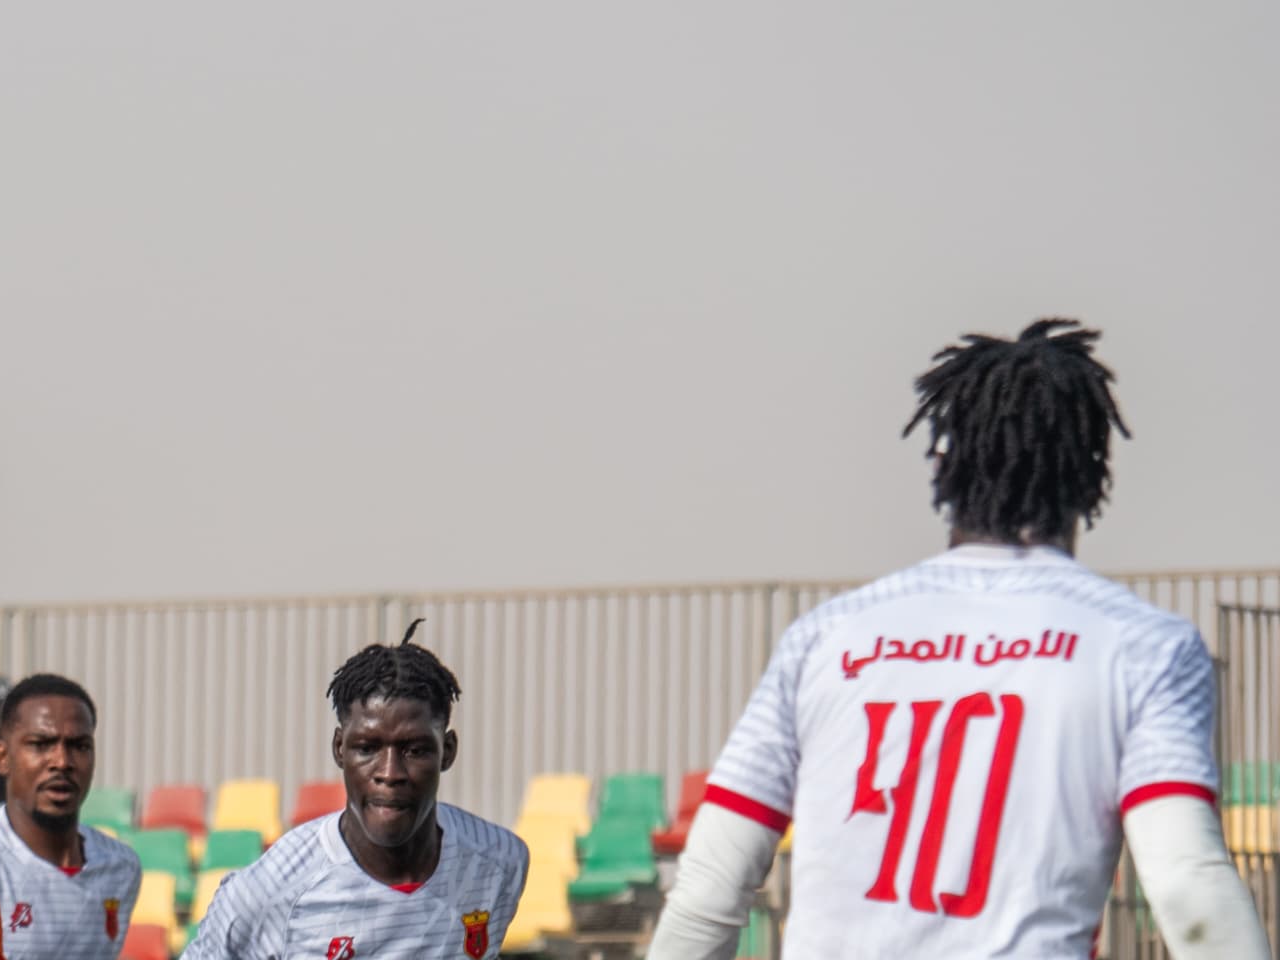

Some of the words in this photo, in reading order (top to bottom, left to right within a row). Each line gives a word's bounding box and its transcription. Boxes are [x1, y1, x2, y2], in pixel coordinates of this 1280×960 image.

[841, 634, 966, 680] المدني
[973, 629, 1078, 668] الأمن
[843, 691, 1025, 920] 40
